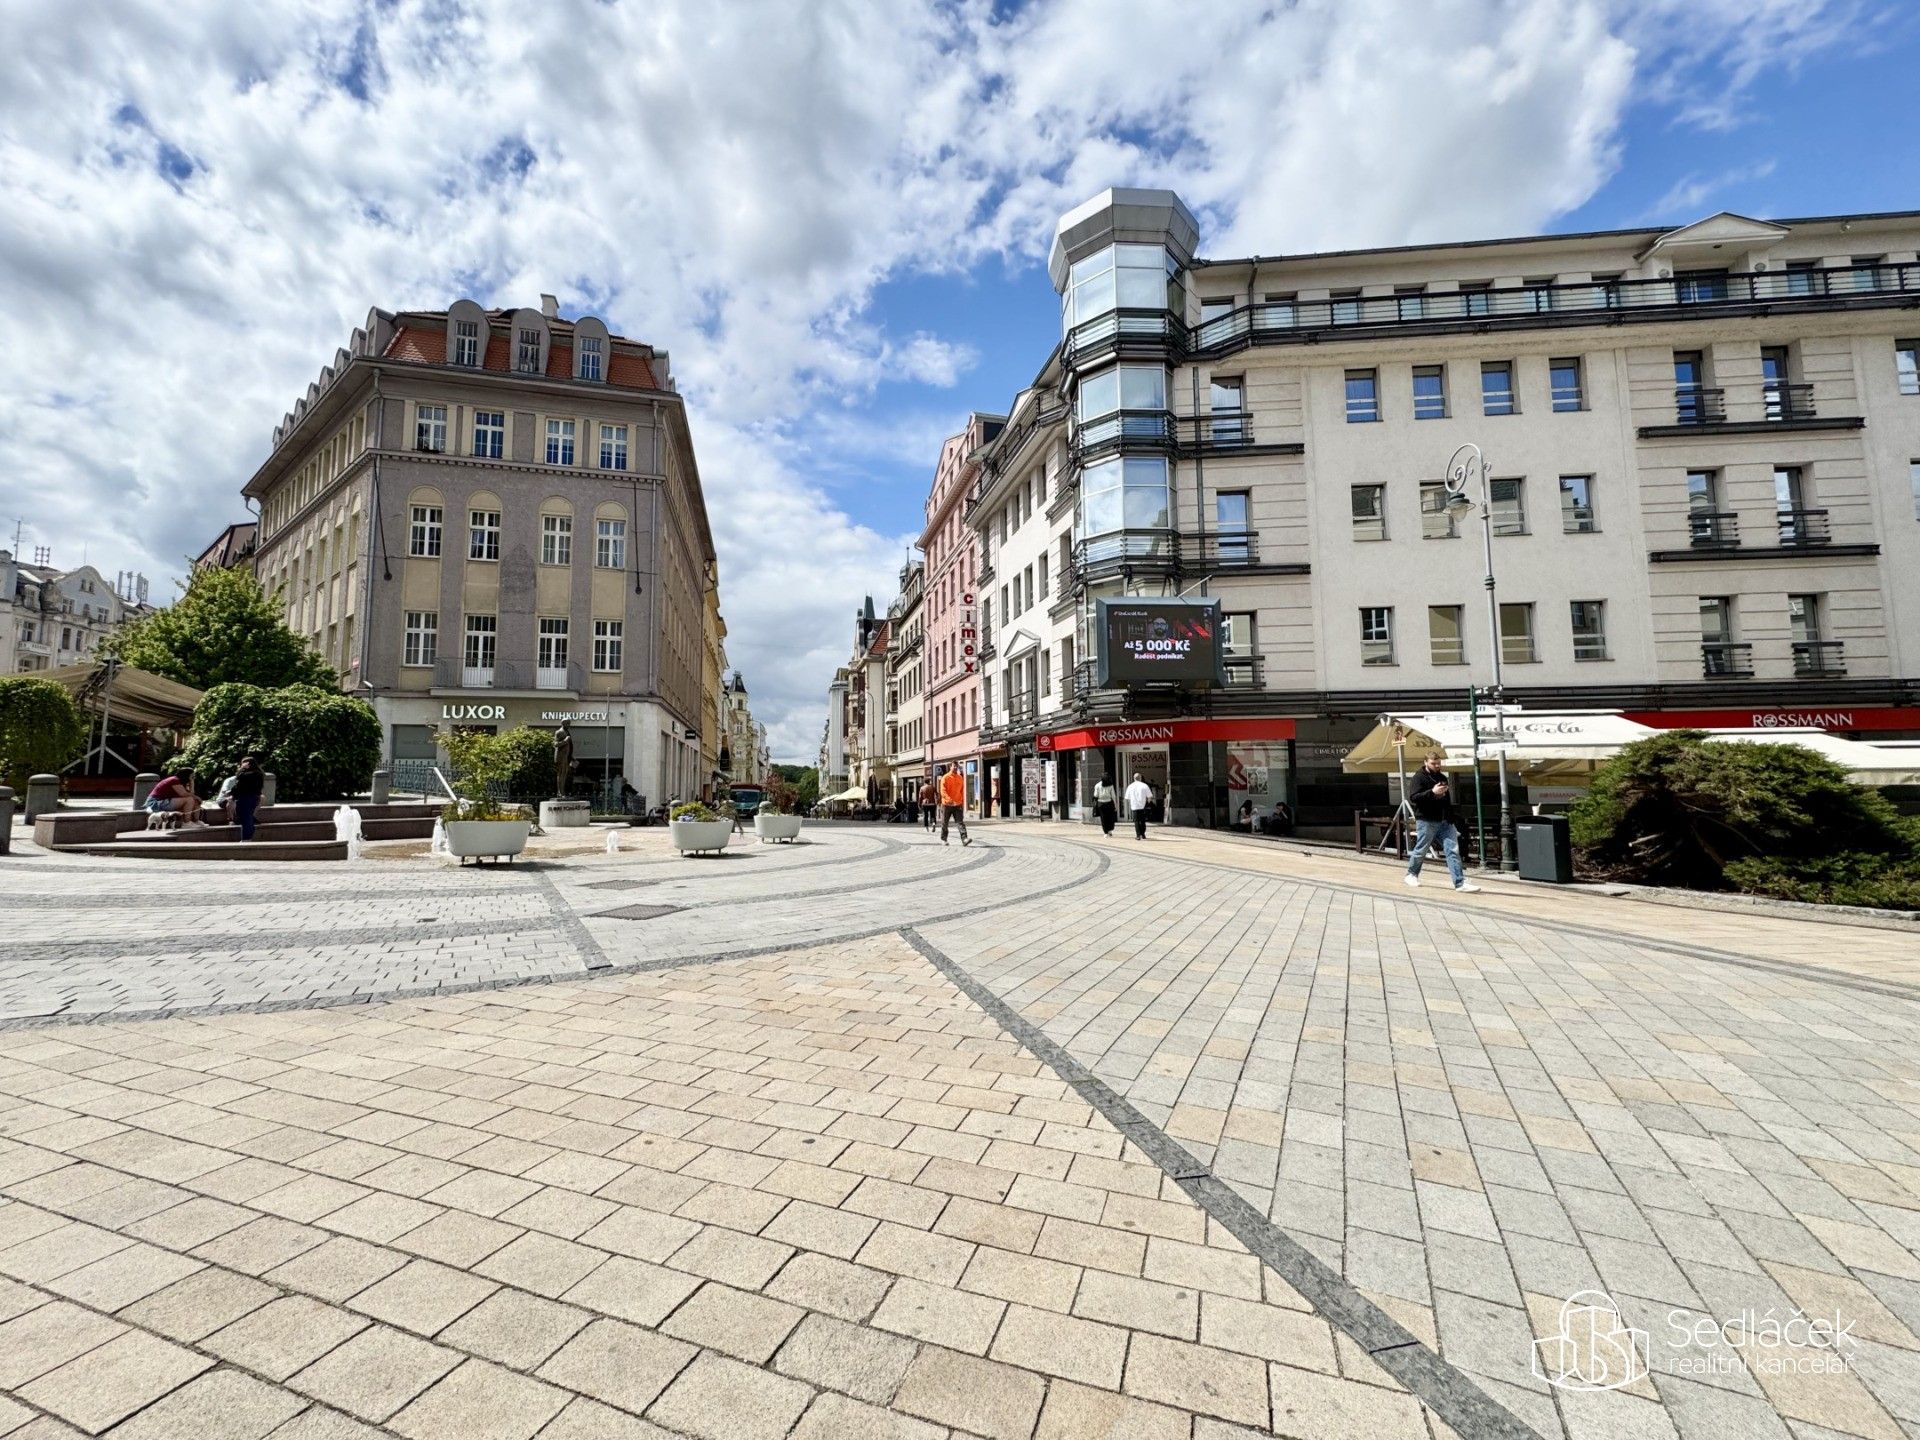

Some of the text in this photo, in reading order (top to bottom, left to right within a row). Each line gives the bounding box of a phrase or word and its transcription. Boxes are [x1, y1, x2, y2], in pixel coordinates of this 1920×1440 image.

[961, 593, 976, 673] cimex
[1135, 640, 1143, 651] 5
[1146, 640, 1172, 651] 000
[1175, 640, 1191, 651] Kč
[443, 705, 506, 720] LUXOR
[541, 711, 608, 721] KNIHKUPECTV
[1753, 713, 1853, 727] ROSSMANN
[1100, 727, 1174, 742] ROSSMANN
